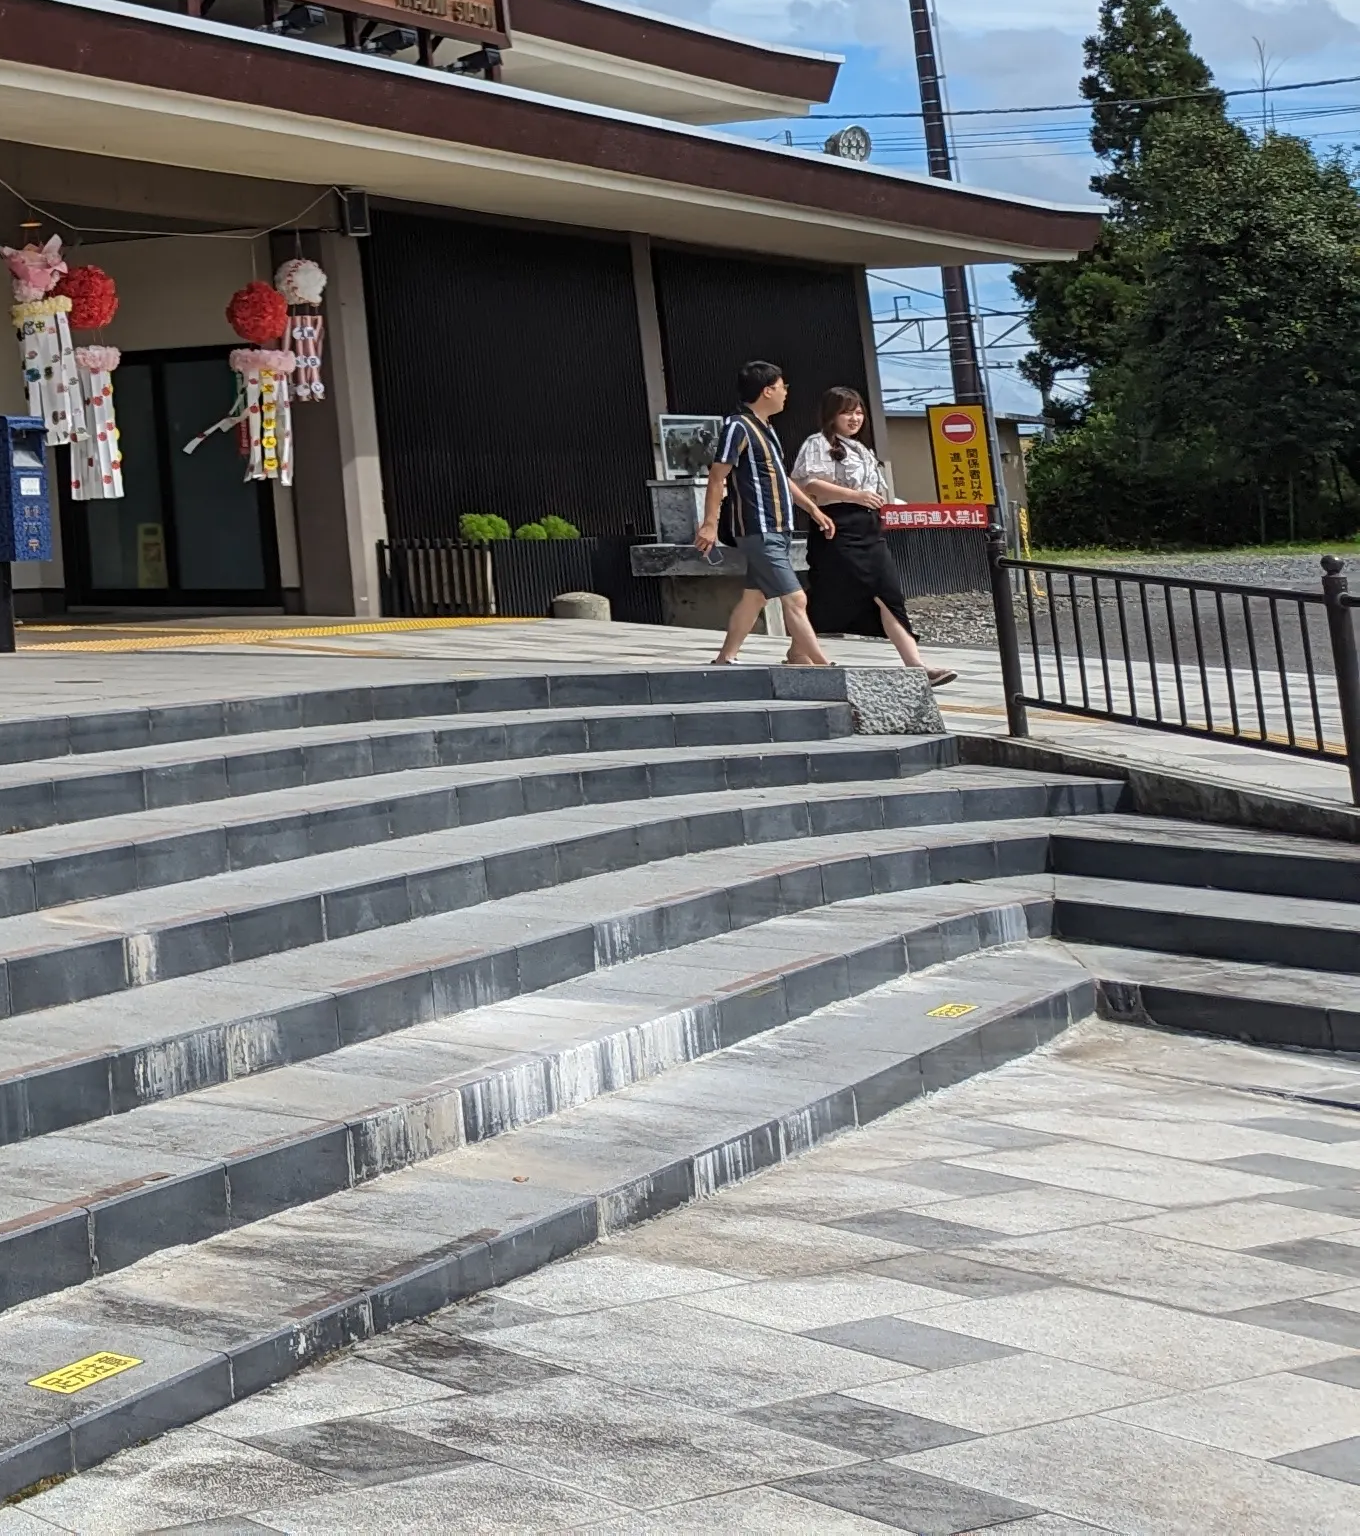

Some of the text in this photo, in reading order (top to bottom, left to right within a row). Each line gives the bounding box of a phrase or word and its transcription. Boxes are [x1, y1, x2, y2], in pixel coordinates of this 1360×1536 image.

[949, 452, 968, 500] 進入禁止
[966, 448, 984, 501] 関係者以外
[881, 510, 985, 526] 般車両進入禁止
